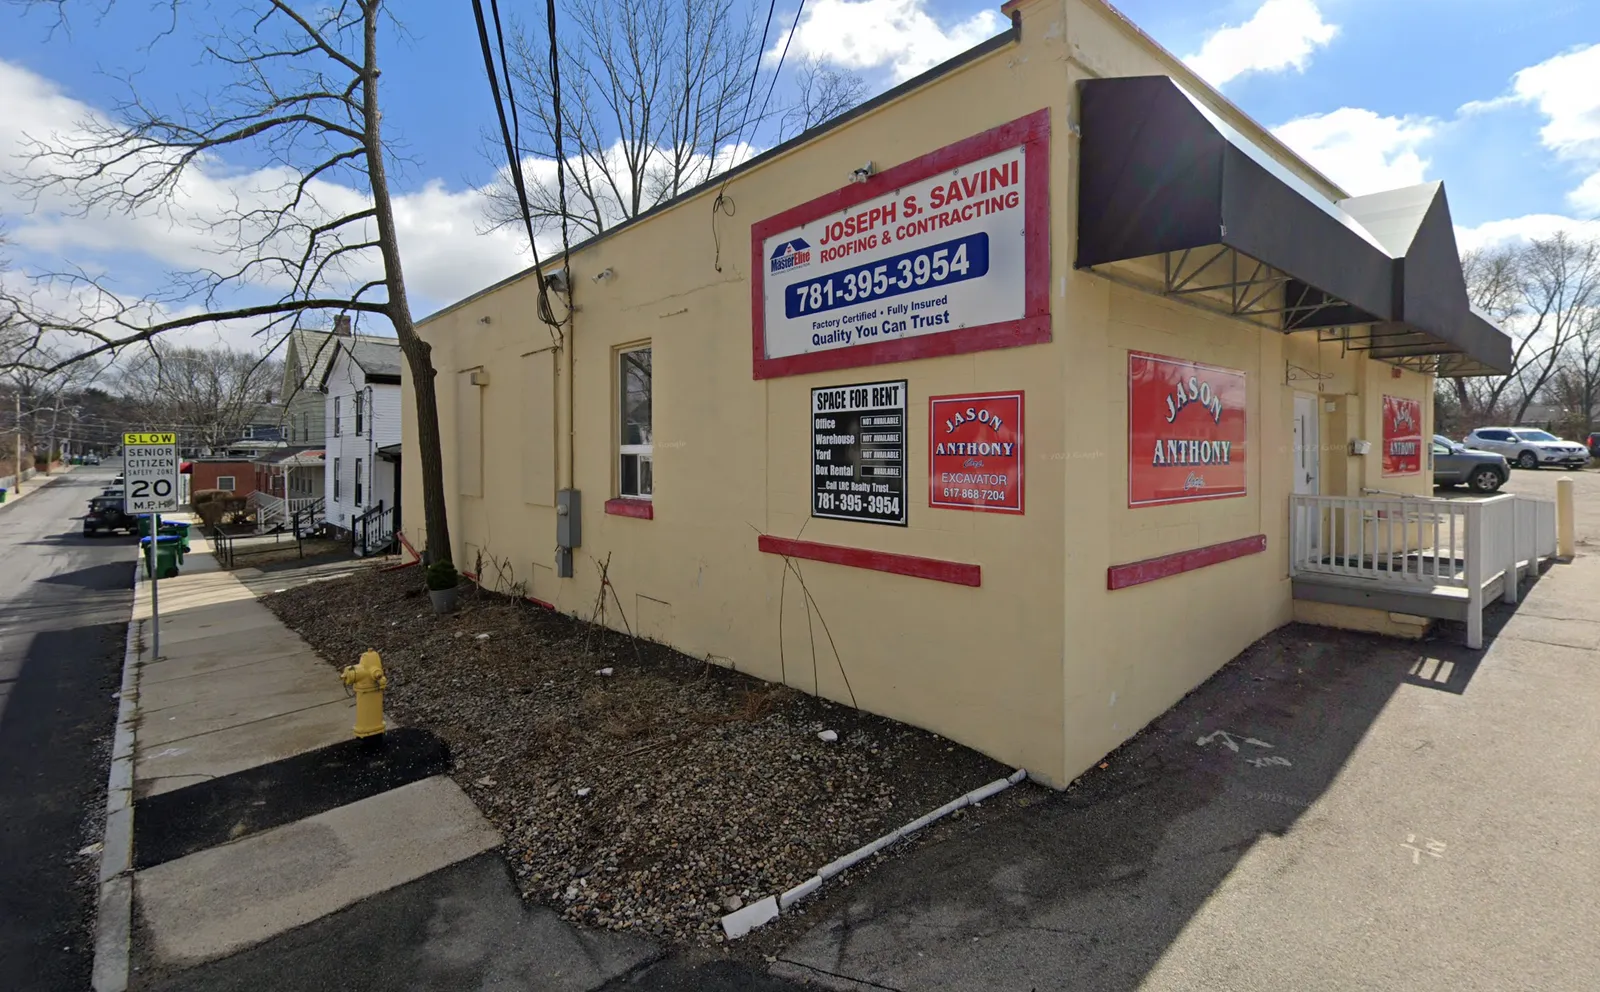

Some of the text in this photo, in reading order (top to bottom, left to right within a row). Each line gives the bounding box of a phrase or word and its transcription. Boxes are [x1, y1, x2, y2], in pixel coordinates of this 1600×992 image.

[820, 160, 1019, 245] JOSEPH S. SAVINI
[820, 191, 1019, 264] ROOFING & CONTRACTING
[796, 243, 970, 312] 781-395-3954
[812, 295, 948, 330] Factory Certified Fully Insured
[812, 310, 950, 346] Quality You Can Trust
[817, 386, 899, 410] SPACE FOR RENT
[1165, 376, 1223, 424] JASON
[816, 418, 835, 429] Office
[945, 407, 1003, 433] JASON
[128, 434, 172, 443] SLOW
[816, 434, 854, 445] Warehouse
[874, 433, 899, 442] AVAILABLE
[129, 448, 172, 456] SENIOR
[816, 450, 831, 460] Yard
[874, 450, 899, 458] AVAILABLE
[935, 442, 1014, 457] ANTHONY
[1152, 439, 1231, 467] ANTHONY
[1389, 440, 1416, 456] ANTHONY
[128, 459, 173, 468] CITIZEN
[816, 465, 853, 476] Box Rental
[874, 467, 899, 475] AVAILABLE
[826, 481, 889, 493] Call LRC Realty Trust
[941, 473, 1007, 486] EXCAVATOR
[131, 480, 171, 497] 20
[817, 493, 899, 515] 781-395-3954
